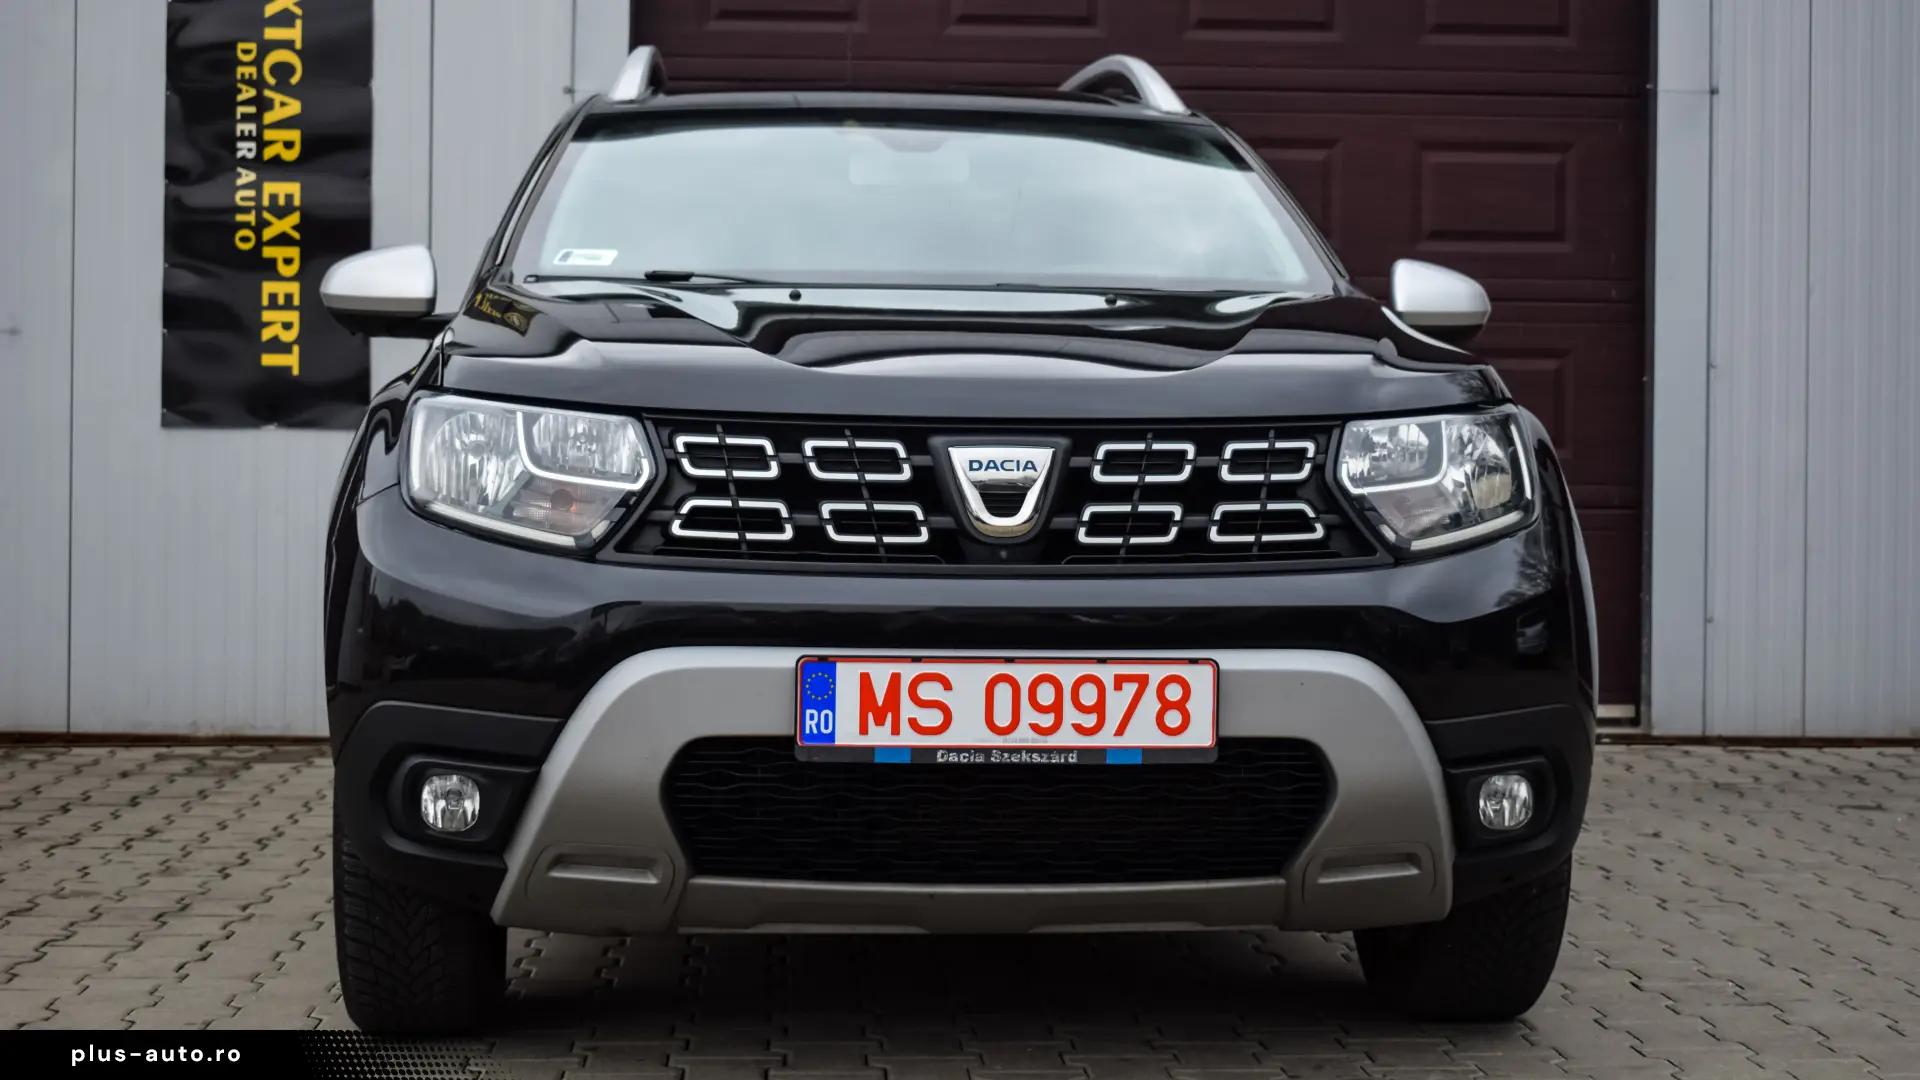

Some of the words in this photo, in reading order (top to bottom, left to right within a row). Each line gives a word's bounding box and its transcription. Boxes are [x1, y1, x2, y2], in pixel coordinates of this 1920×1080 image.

[236, 42, 258, 159] DEALER
[235, 167, 257, 251] AUTO
[260, 181, 302, 376] EXPERT
[968, 460, 1038, 472] DACIA
[805, 709, 833, 734] RO
[859, 672, 953, 736] MS
[985, 673, 1192, 737] 09978
[936, 750, 985, 763] Dacia
